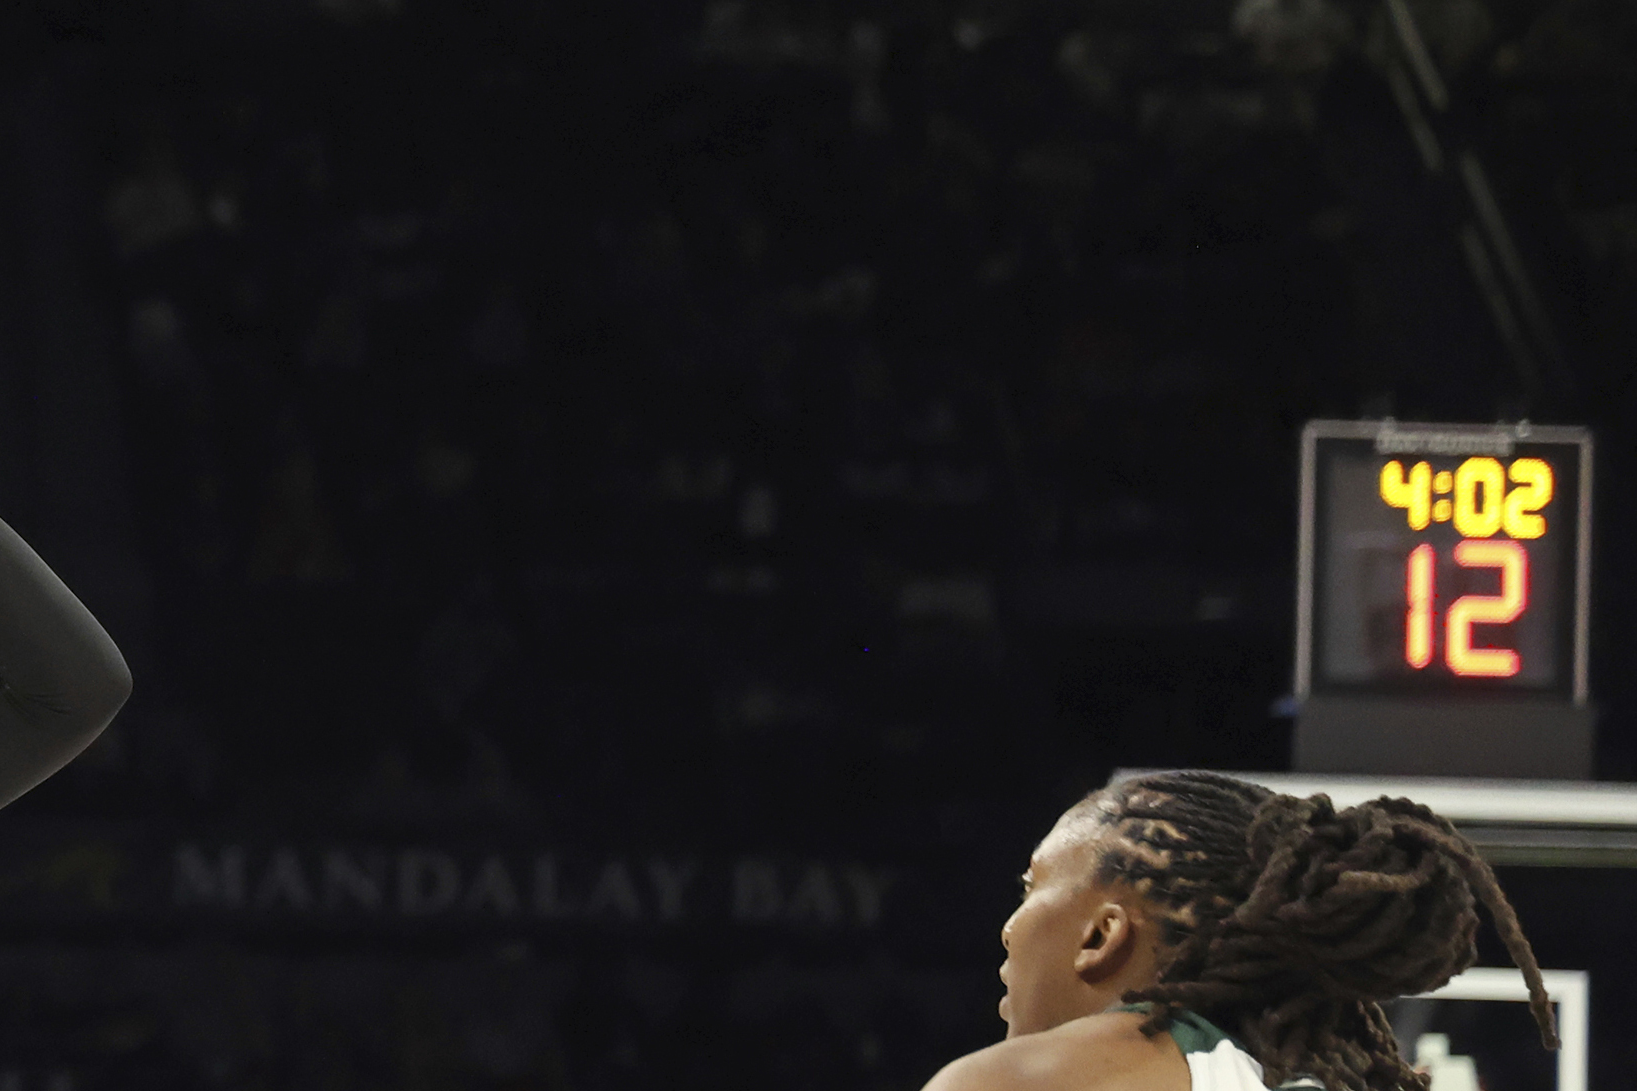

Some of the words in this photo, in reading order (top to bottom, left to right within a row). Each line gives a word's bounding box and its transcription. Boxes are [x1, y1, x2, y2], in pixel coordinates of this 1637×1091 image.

[1380, 457, 1555, 539] 4:02
[1405, 539, 1531, 677] 12
[171, 843, 703, 925] MANDALAY
[729, 857, 903, 927] BAY
